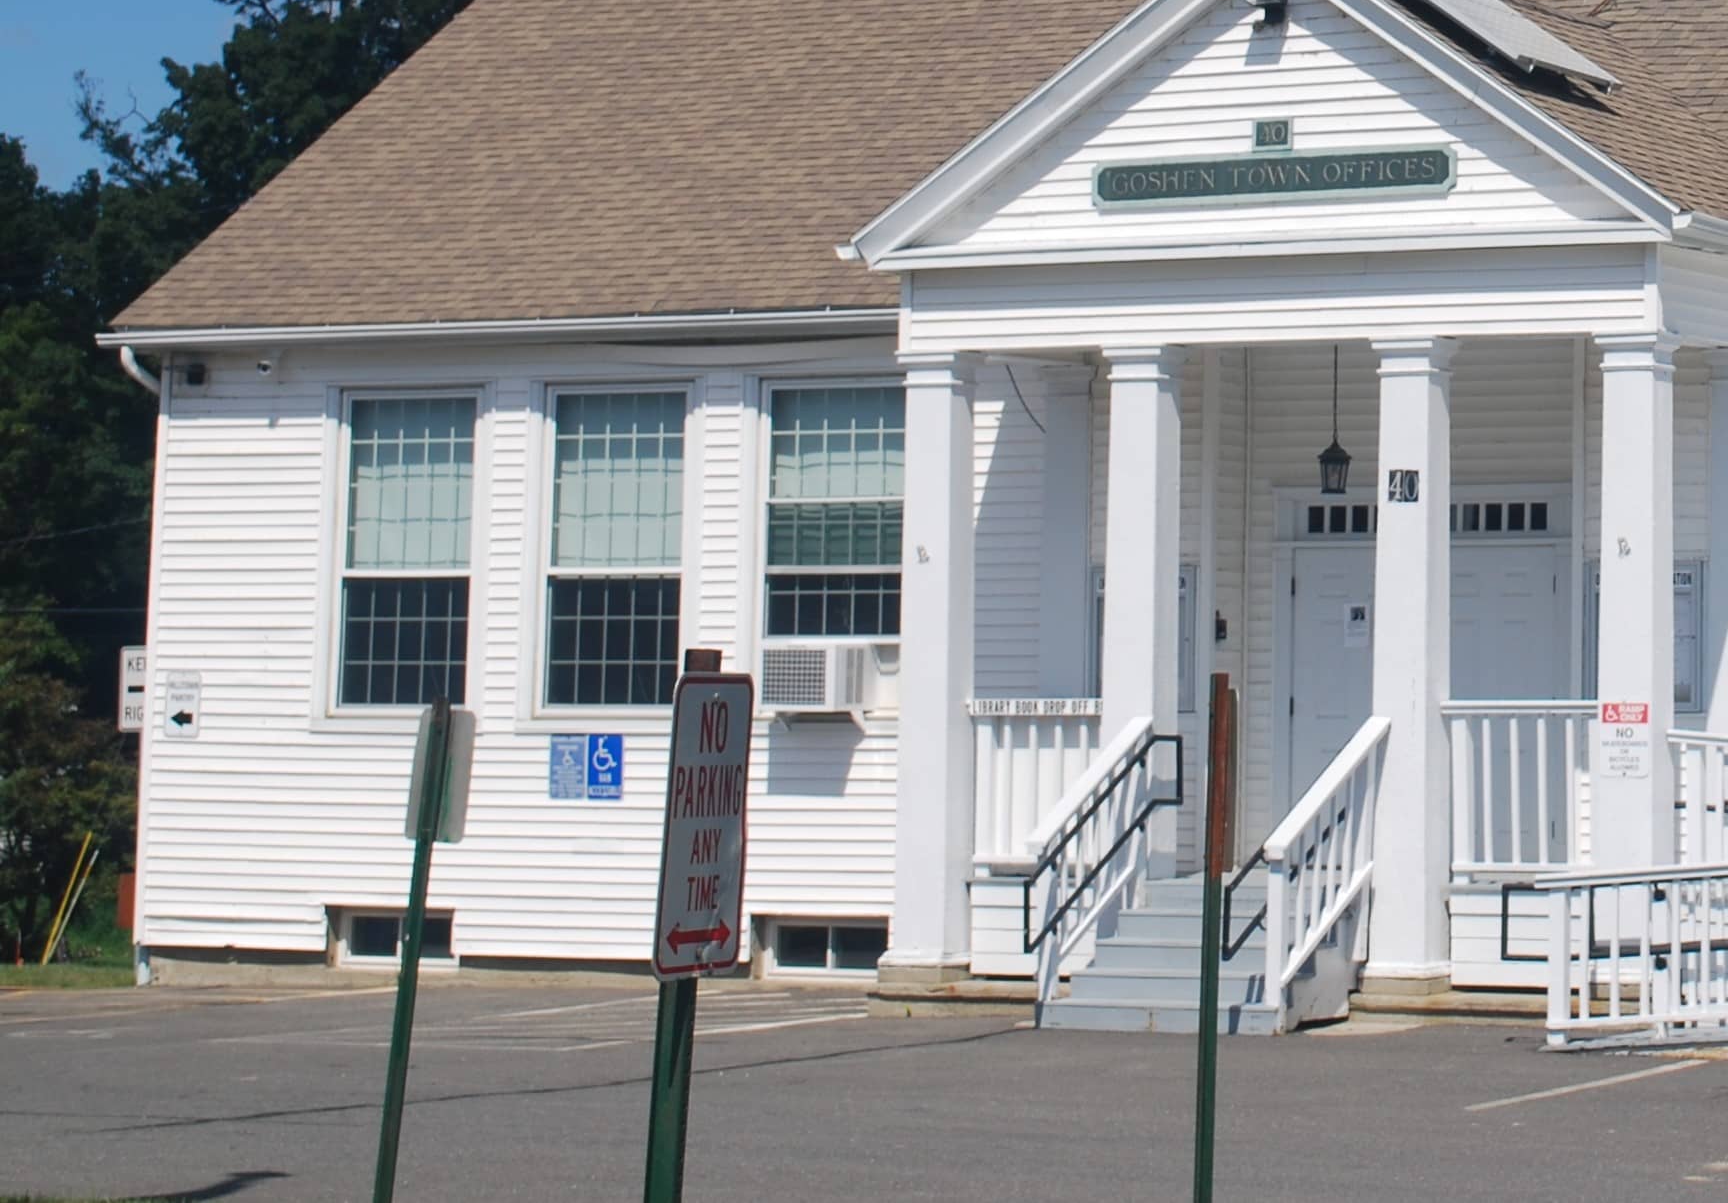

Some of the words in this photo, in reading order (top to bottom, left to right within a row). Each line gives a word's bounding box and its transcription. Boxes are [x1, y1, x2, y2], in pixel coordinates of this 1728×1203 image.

[1262, 123, 1286, 142] 40
[1112, 168, 1215, 195] GOSHEN
[1229, 161, 1311, 188] TOWN
[1322, 156, 1436, 183] OFFICES
[1389, 470, 1419, 501] 40
[973, 700, 1010, 713] LIBRARY
[1016, 700, 1038, 713] BOOK
[1044, 700, 1066, 713] DROP
[1071, 700, 1088, 713] OFF
[1619, 705, 1645, 713] RAMP
[1619, 713, 1643, 721] ONLY
[700, 701, 728, 753] NO
[1616, 727, 1634, 738] NO
[674, 765, 742, 819] PARKING
[690, 829, 722, 864] ANY
[687, 875, 720, 911] TIME
